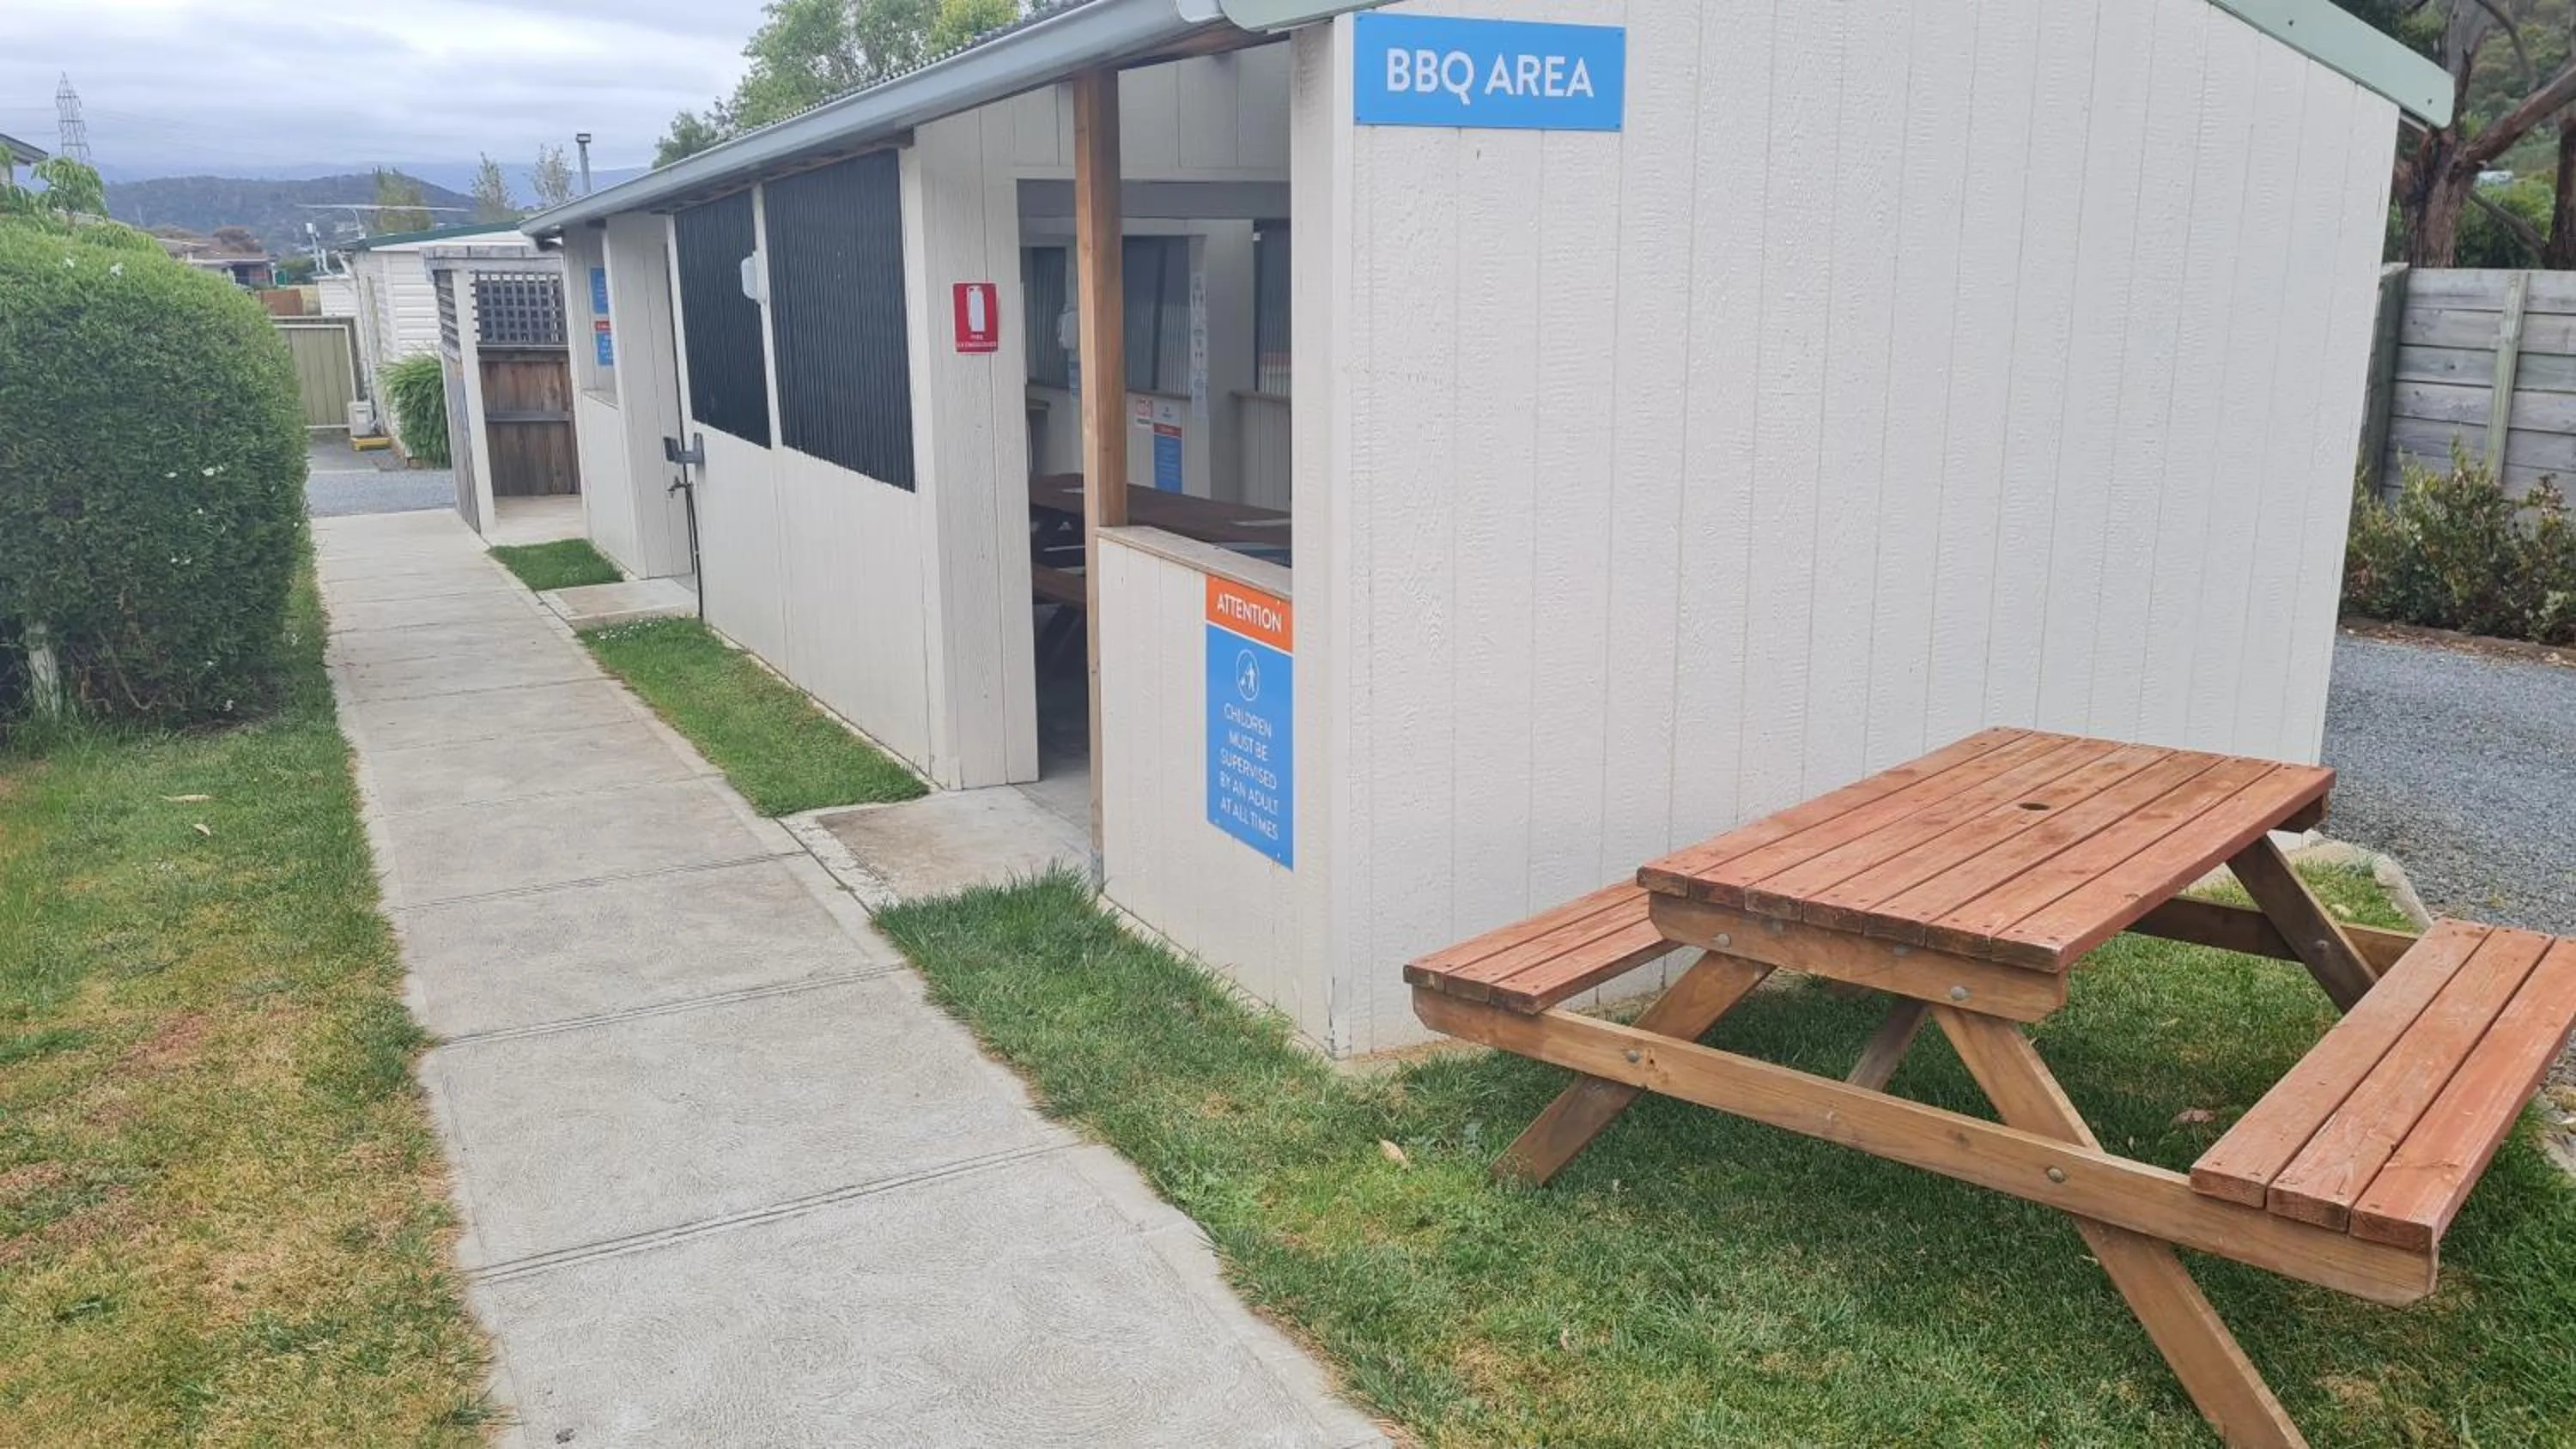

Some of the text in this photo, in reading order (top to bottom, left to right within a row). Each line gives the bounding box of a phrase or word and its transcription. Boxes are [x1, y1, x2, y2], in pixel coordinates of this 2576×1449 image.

[1387, 47, 1595, 105] BBQ AREA
[1217, 593, 1282, 632] ATTENTION
[1224, 702, 1272, 738] CHILDREN
[1229, 730, 1269, 761] MUST BE
[1220, 748, 1277, 790] SUPERVISED
[1220, 796, 1279, 840] AT ALL TIMES
[1248, 787, 1278, 816] ADULT
